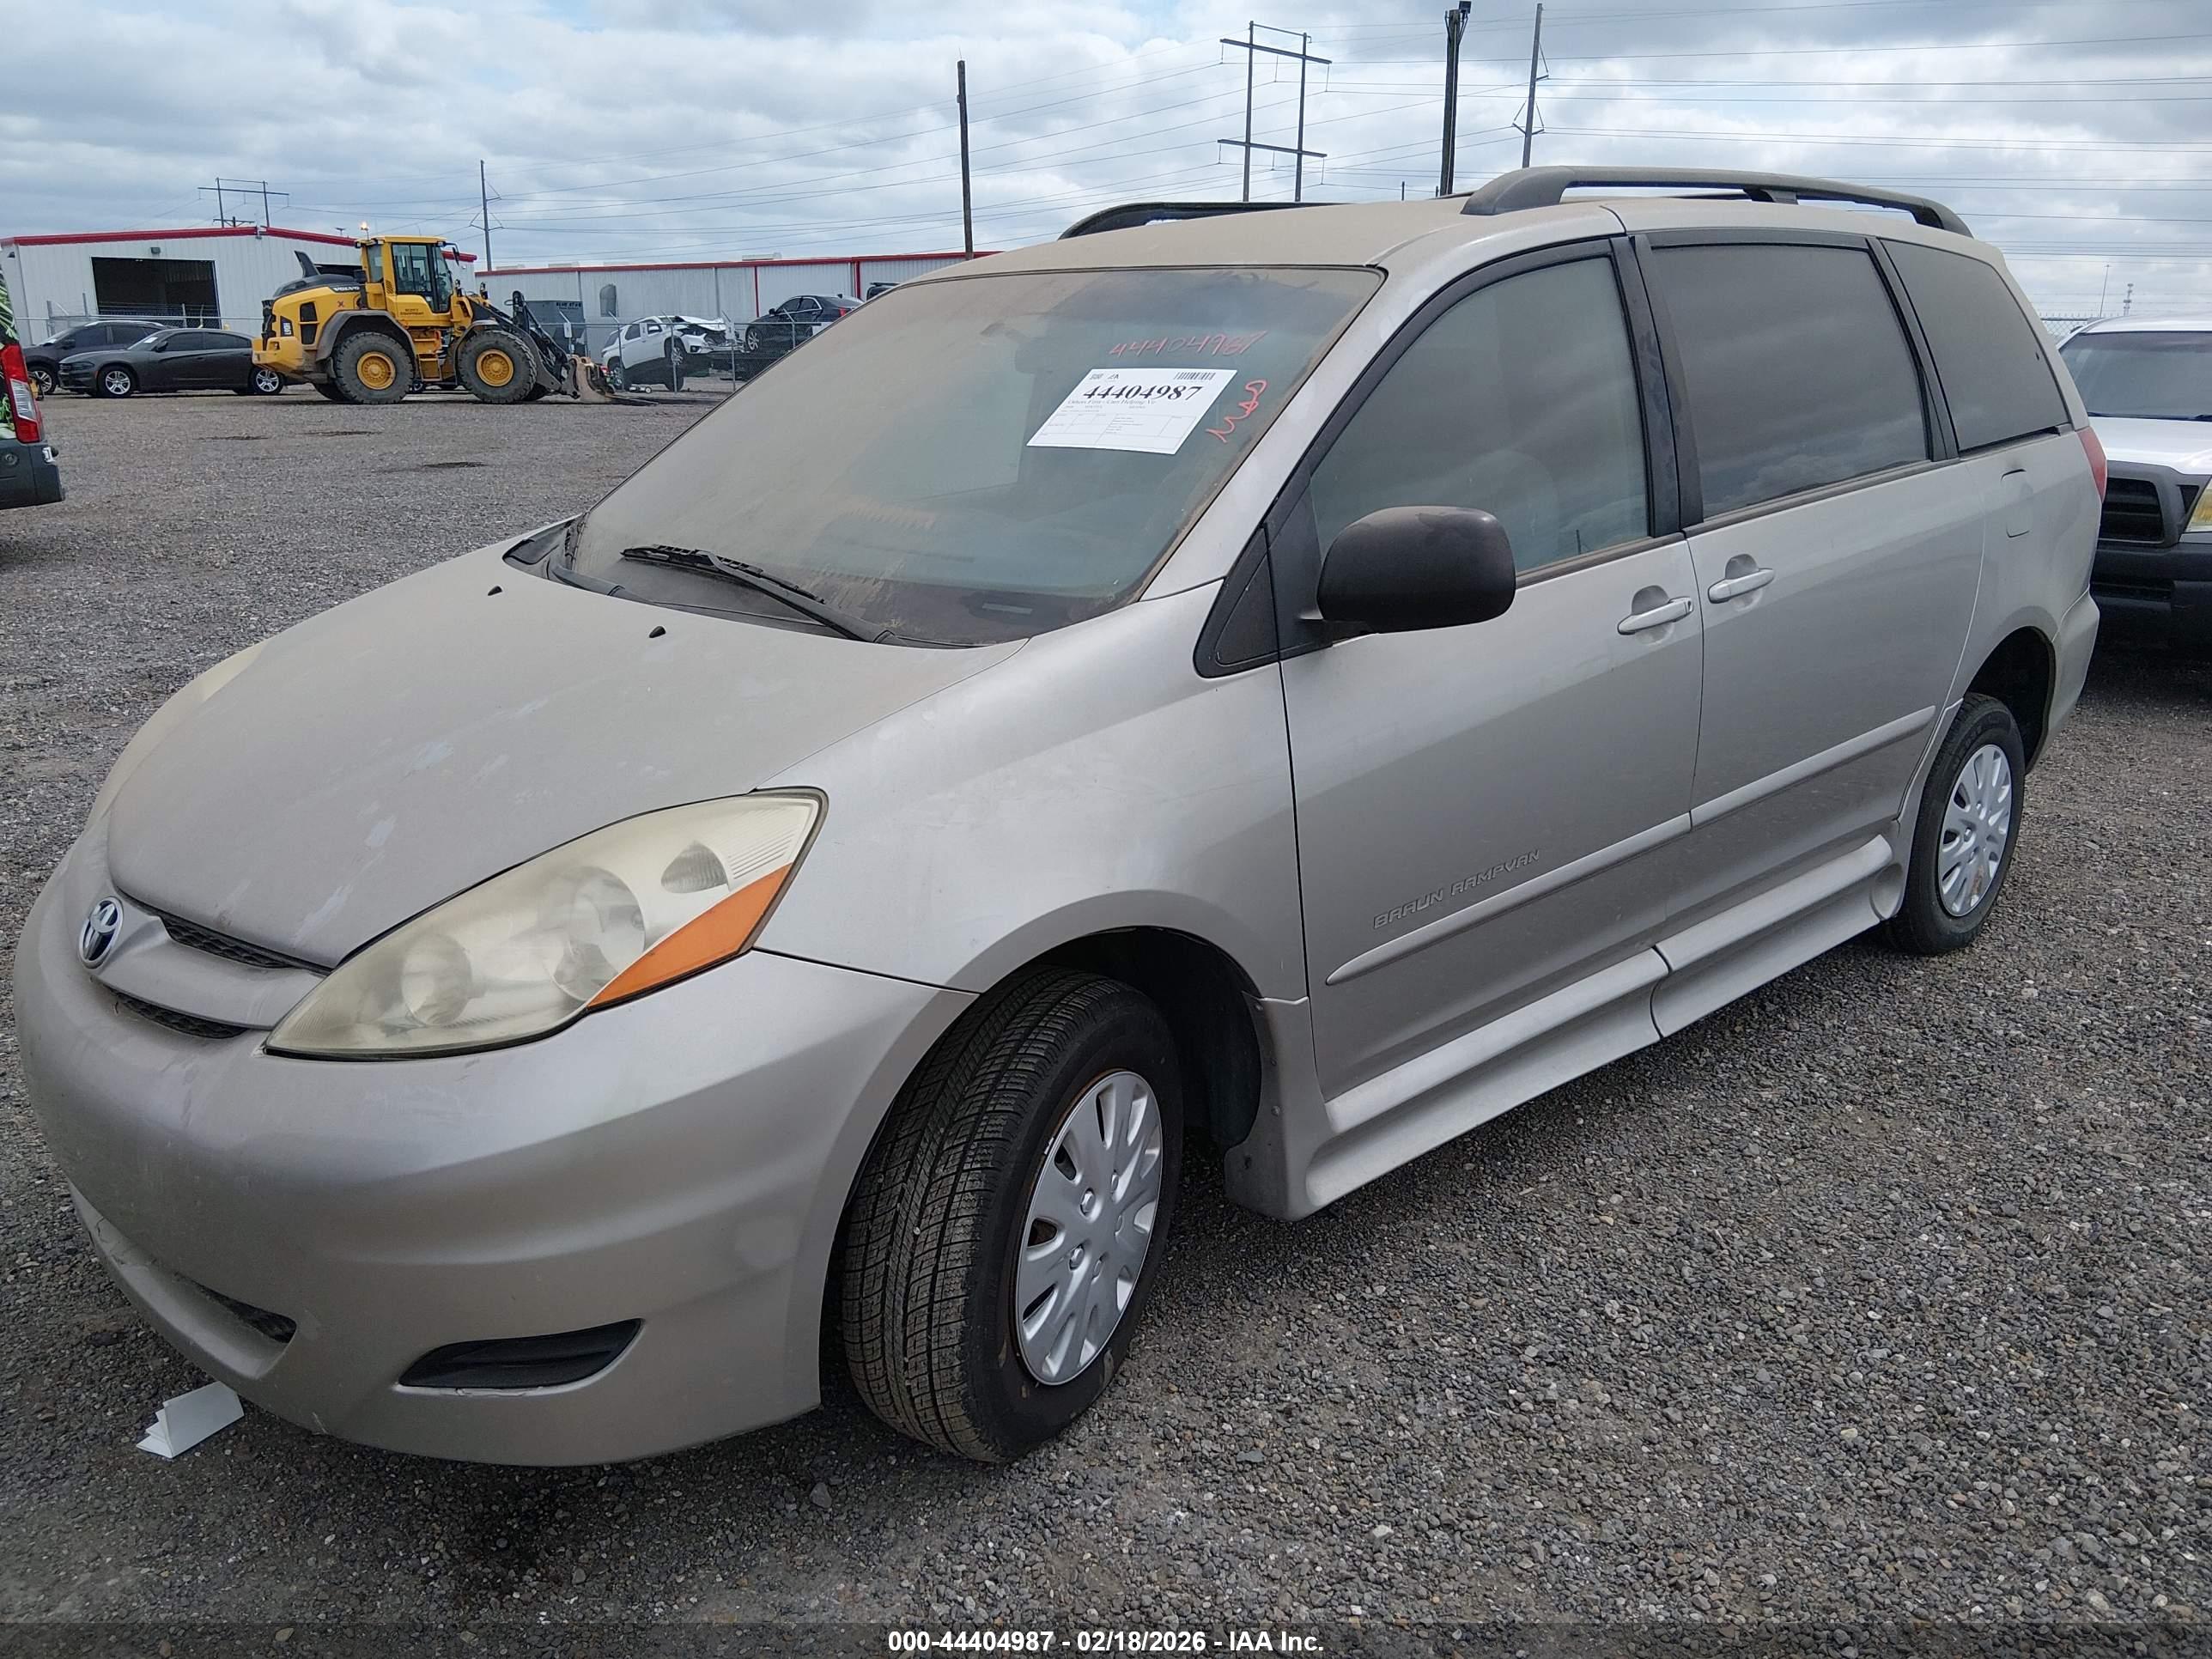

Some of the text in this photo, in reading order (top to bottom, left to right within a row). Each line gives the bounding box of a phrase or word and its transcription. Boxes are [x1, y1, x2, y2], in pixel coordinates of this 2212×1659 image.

[1109, 330, 1268, 357] 44404987
[1083, 385, 1204, 401] 44404987
[1373, 849, 1540, 930] BRAUN RAMPVAN
